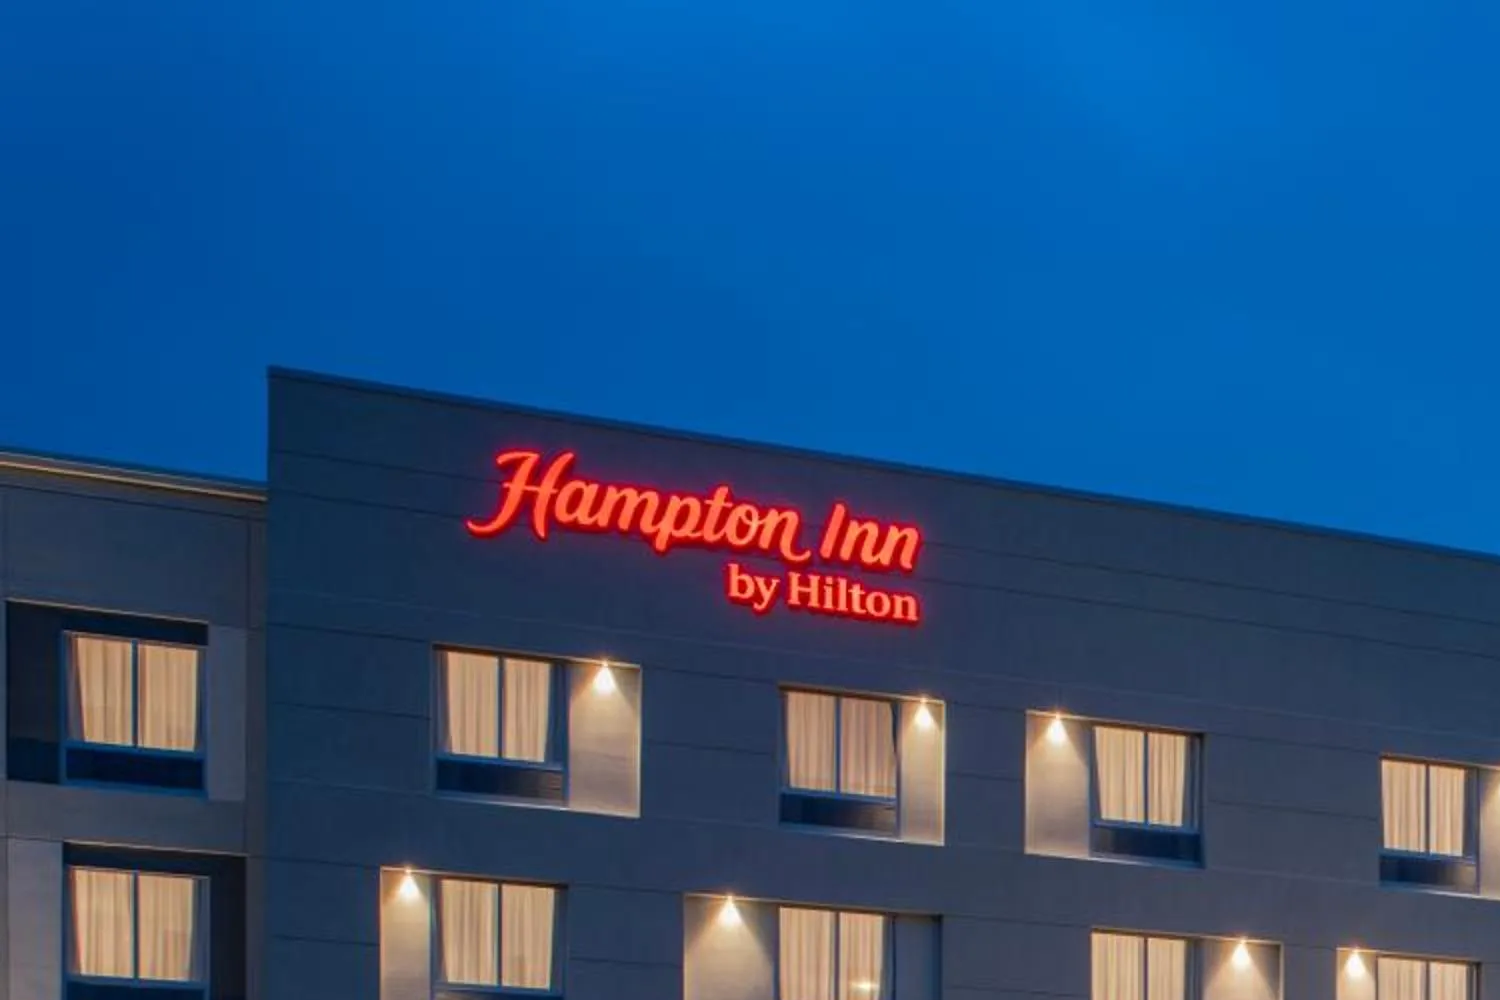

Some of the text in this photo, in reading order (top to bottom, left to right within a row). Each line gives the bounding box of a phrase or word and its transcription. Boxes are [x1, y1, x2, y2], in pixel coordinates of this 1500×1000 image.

[466, 449, 920, 571] Hampton Inn
[727, 563, 919, 622] by Hilton
